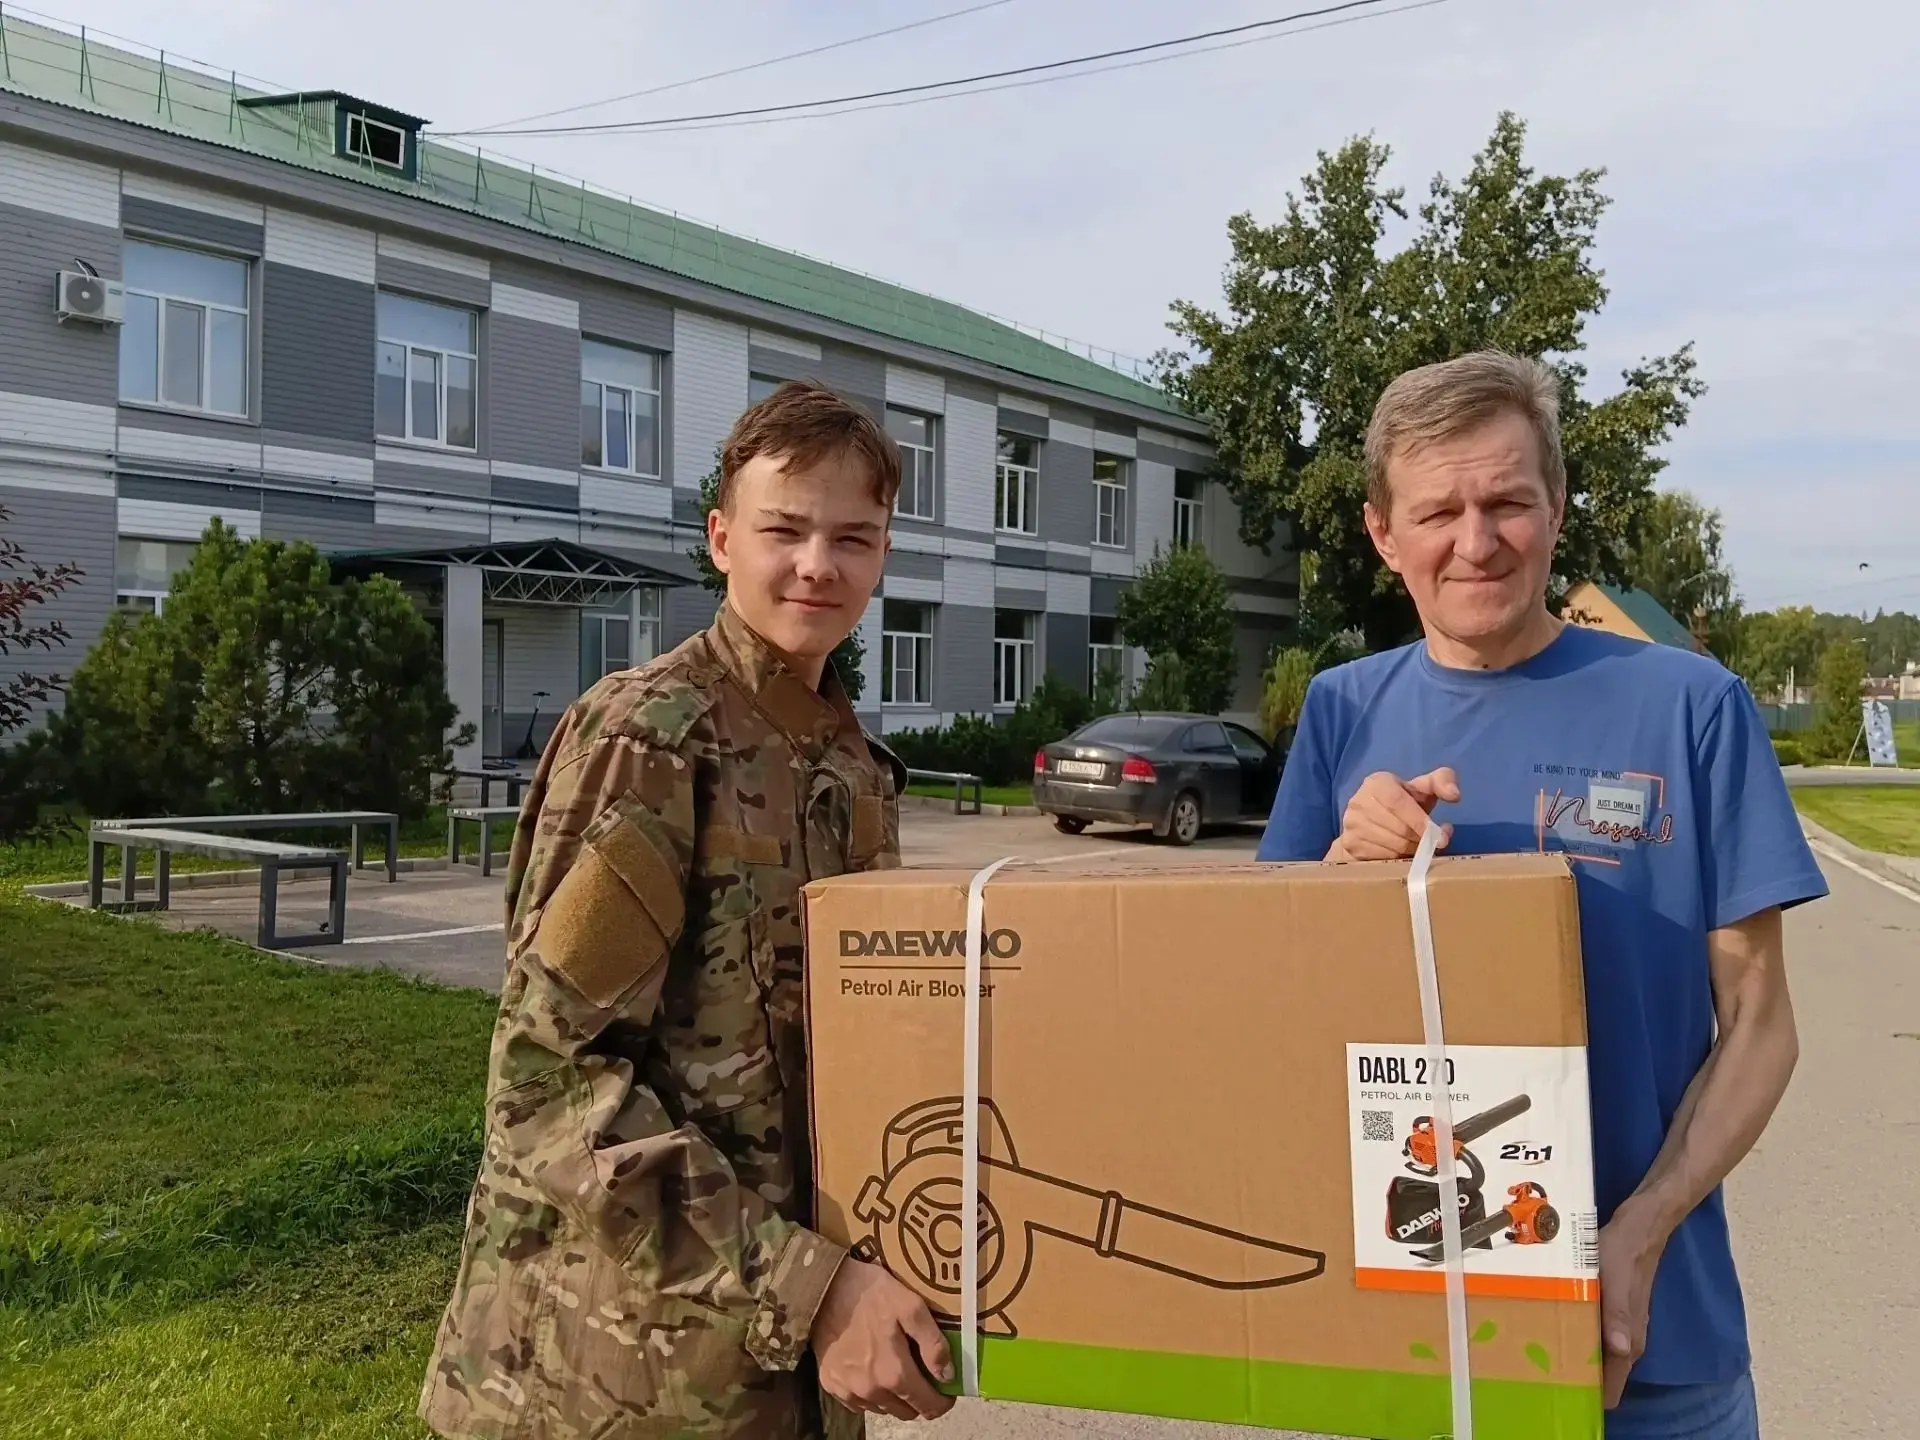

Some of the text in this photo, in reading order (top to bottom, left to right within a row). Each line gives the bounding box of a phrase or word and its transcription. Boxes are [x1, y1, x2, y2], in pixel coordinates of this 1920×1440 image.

[1534, 763, 1543, 773] BE
[1546, 764, 1563, 775] KIND
[1566, 766, 1576, 776] TO
[1579, 767, 1598, 778] YOUR
[1597, 799, 1611, 807] JUST
[1613, 800, 1634, 811] DREAM
[841, 979, 996, 998] Petrol Air Bloer
[1358, 1056, 1411, 1084] DABL
[1361, 1091, 1470, 1102] PETROL AIR BWER
[1396, 1194, 1470, 1239] DAEWO
